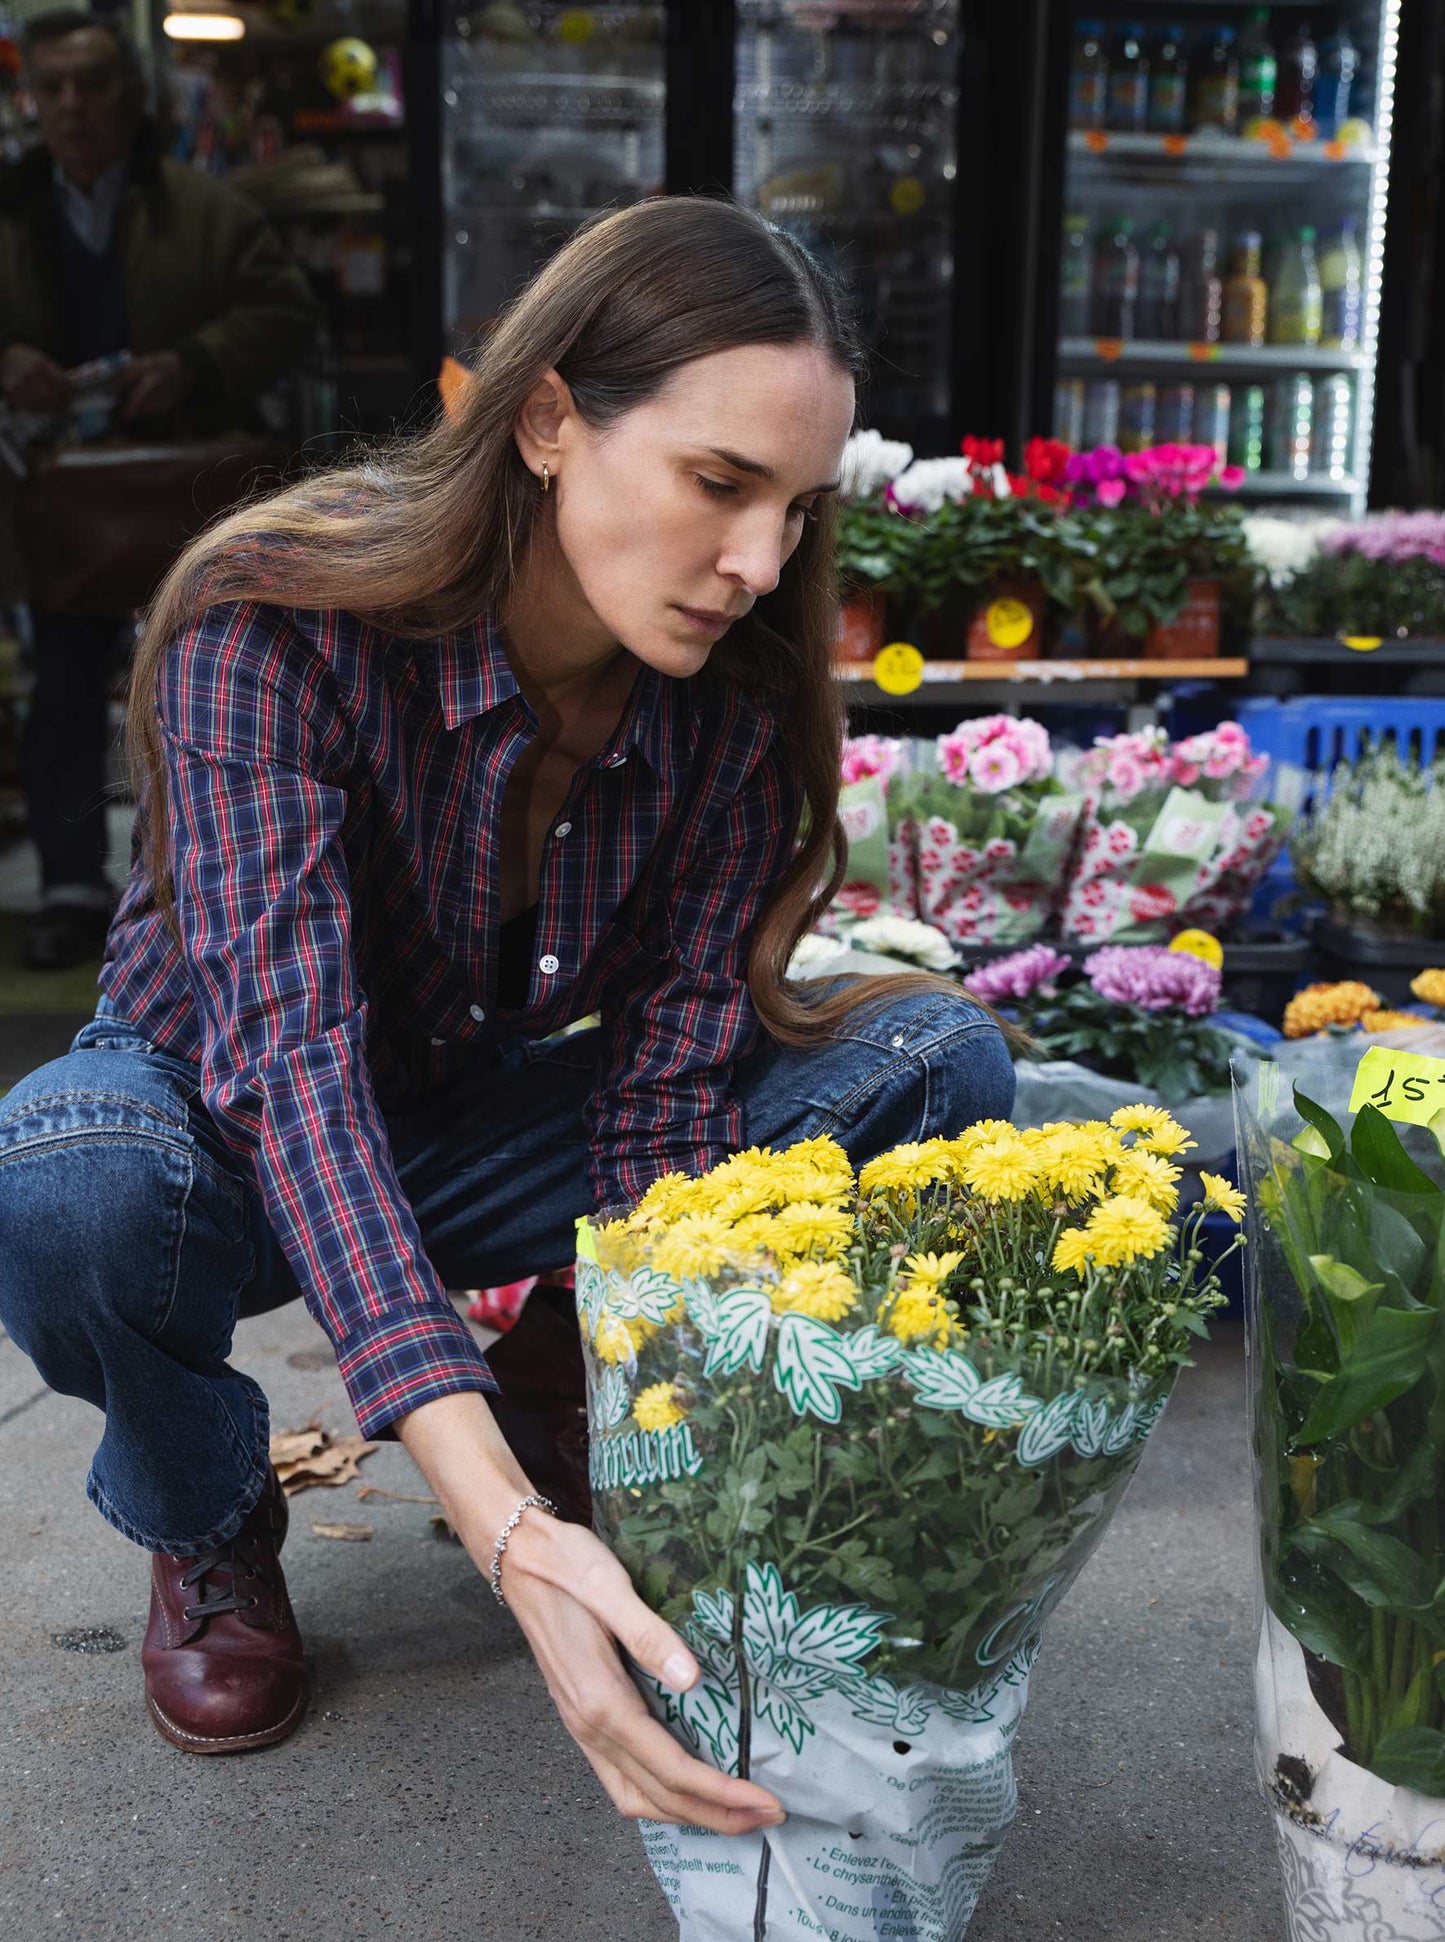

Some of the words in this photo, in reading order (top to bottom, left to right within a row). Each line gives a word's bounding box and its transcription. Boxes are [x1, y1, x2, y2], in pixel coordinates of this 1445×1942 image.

[1371, 1069, 1445, 1109] 15
[813, 1857, 831, 1873] Le
[829, 1847, 878, 1868] Enlevez
[891, 1889, 907, 1904] En
[825, 1895, 860, 1917] Dans
[861, 1908, 878, 1918] un
[879, 1905, 919, 1920] endroit
[796, 1908, 824, 1936] Tous
[829, 1930, 840, 1942] 8
[879, 1922, 924, 1938] Enlevez
